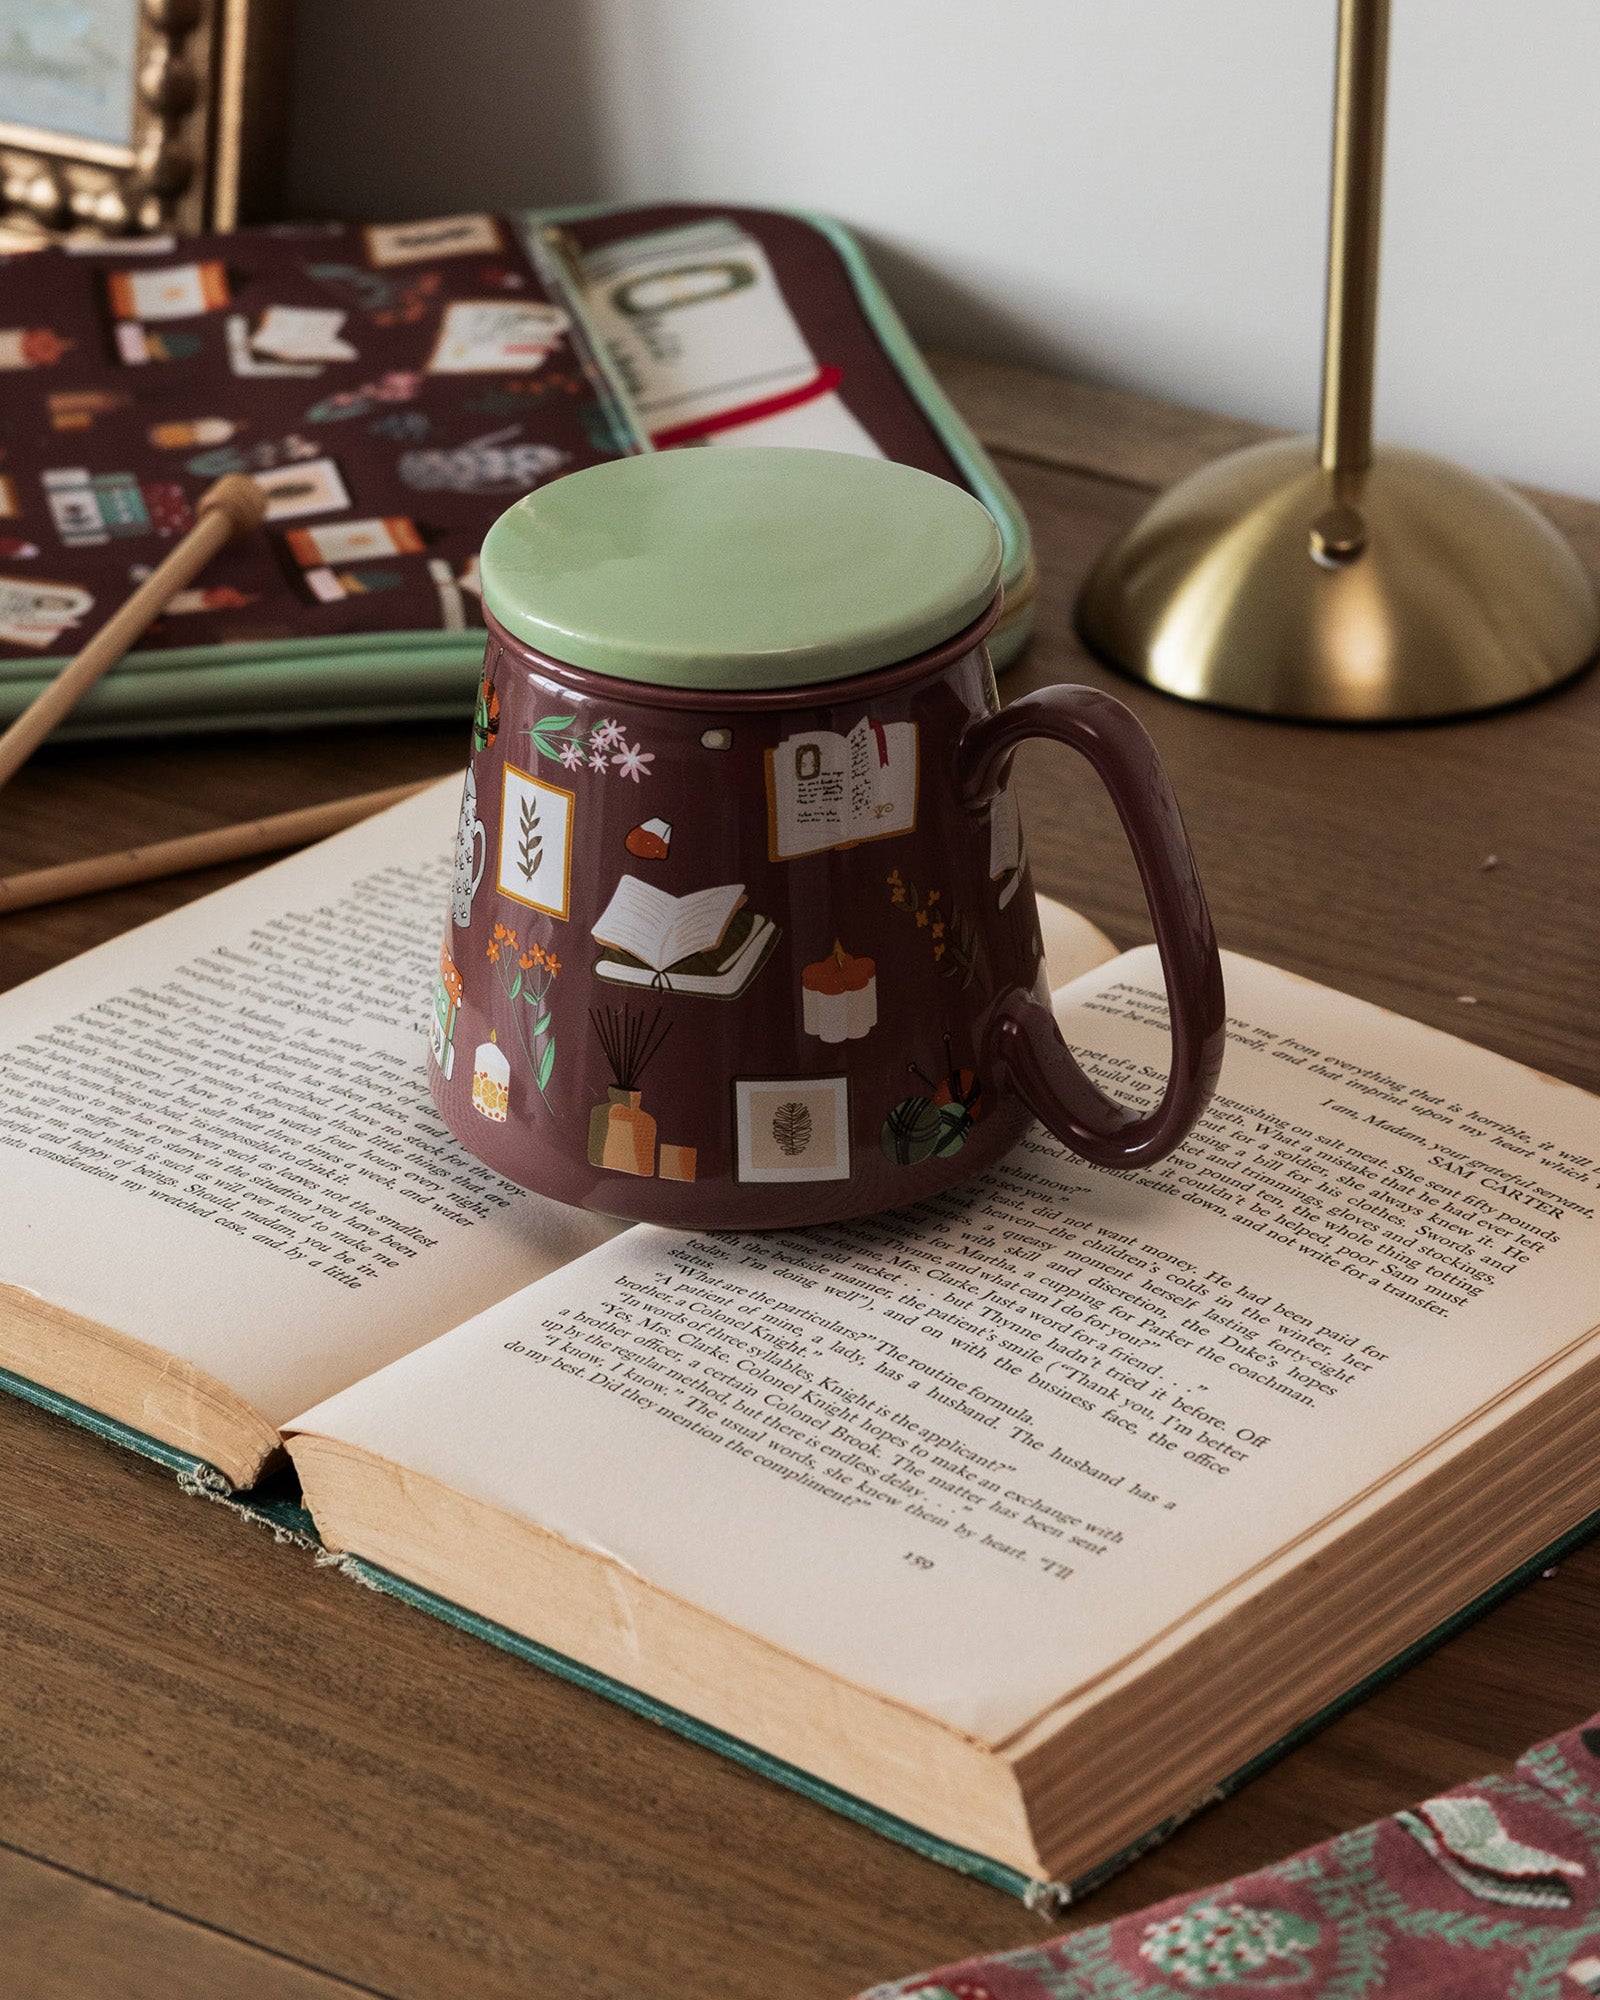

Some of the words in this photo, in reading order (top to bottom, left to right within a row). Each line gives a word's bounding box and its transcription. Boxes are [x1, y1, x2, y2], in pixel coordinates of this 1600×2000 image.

[332, 1103, 349, 1112] I
[344, 1107, 381, 1126] have
[380, 1125, 403, 1136] no
[402, 1136, 445, 1156] stock
[439, 1154, 469, 1167] for
[467, 1166, 496, 1181] the
[496, 1180, 526, 1198] voy-
[1252, 1027, 1279, 1040] me
[1277, 1038, 1321, 1057] from
[1324, 1056, 1406, 1092] everything
[1408, 1088, 1445, 1105] that
[1446, 1103, 1463, 1113] is
[1465, 1110, 1531, 1144] horrible,
[1537, 1141, 1555, 1151] it
[1558, 1150, 1593, 1167] will
[1271, 1050, 1308, 1066] and
[1307, 1064, 1343, 1081] that
[1345, 1078, 1408, 1106] imprint
[1410, 1105, 1454, 1124] upon
[1458, 1124, 1487, 1137] my
[1490, 1135, 1536, 1158] heart
[1540, 1158, 1589, 1182] which
[1320, 1098, 1335, 1107] I
[1330, 1105, 1359, 1120] am,
[1362, 1114, 1426, 1146] Madam,
[1427, 1143, 1470, 1160] your
[1465, 1160, 1537, 1188] grateful
[1532, 1187, 1594, 1219] servant,
[29, 1147, 118, 1181] consideration
[120, 1179, 147, 1192] my
[148, 1189, 218, 1218] wretched
[214, 1217, 247, 1236] case,
[284, 1246, 308, 1260] by
[308, 1260, 323, 1268] a
[322, 1265, 362, 1289] little
[37, 1132, 72, 1145] and
[67, 1140, 112, 1161] happy
[112, 1158, 136, 1169] of
[131, 1164, 179, 1188] beings.
[183, 1183, 240, 1212] Should,
[241, 1210, 296, 1239] madam,
[297, 1236, 332, 1252] you
[332, 1250, 356, 1264] be
[356, 1263, 378, 1278] in-
[1064, 1152, 1086, 1166] he
[1087, 1161, 1139, 1182] would
[1135, 1177, 1180, 1196] settle
[1181, 1192, 1227, 1217] down,
[1231, 1214, 1269, 1232] and
[1265, 1230, 1297, 1247] not
[1298, 1244, 1340, 1267] write
[1340, 1263, 1369, 1280] for
[1367, 1277, 1380, 1286] a
[1382, 1282, 1448, 1318] transfer.
[1158, 1167, 1176, 1178] it
[1178, 1176, 1246, 1206] couldn’t
[1248, 1202, 1271, 1217] be
[1273, 1213, 1333, 1247] helped,
[1334, 1245, 1379, 1266] poor
[1380, 1263, 1419, 1286] Sam
[1423, 1284, 1468, 1307] must
[1166, 1154, 1197, 1170] two
[1196, 1167, 1256, 1192] pound
[1255, 1189, 1284, 1209] ten,
[1292, 1205, 1320, 1222] the
[1325, 1220, 1373, 1246] whole
[1376, 1243, 1422, 1270] thing
[1425, 1265, 1484, 1297] totting
[1197, 1119, 1226, 1133] out
[1229, 1130, 1256, 1144] for
[1257, 1143, 1270, 1151] a
[1273, 1150, 1329, 1177] soldier,
[1335, 1175, 1366, 1191] she
[1368, 1190, 1424, 1216] always
[1426, 1212, 1474, 1236] knew
[1476, 1234, 1494, 1248] it.
[1501, 1245, 1530, 1263] He
[1205, 1154, 1242, 1170] and
[1241, 1166, 1323, 1209] trimmings,
[1326, 1206, 1380, 1232] gloves
[1381, 1230, 1418, 1248] and
[1417, 1246, 1495, 1285] stockings,
[1234, 1149, 1247, 1157] a
[1252, 1154, 1284, 1171] bill
[1285, 1169, 1313, 1184] for
[1315, 1181, 1343, 1198] his
[1347, 1197, 1406, 1228] clothes.
[1414, 1225, 1476, 1256] Swords
[1479, 1256, 1517, 1274] and
[1255, 1122, 1300, 1147] What
[1300, 1145, 1313, 1153] a
[1316, 1151, 1378, 1180] mistake
[1380, 1176, 1416, 1196] that
[1416, 1190, 1440, 1206] he
[1441, 1201, 1478, 1221] had
[1476, 1219, 1514, 1237] ever
[1513, 1233, 1545, 1253] left
[1290, 1126, 1313, 1138] on
[1314, 1135, 1345, 1150] salt
[1345, 1147, 1388, 1169] meat.
[1391, 1165, 1425, 1183] She
[1424, 1181, 1462, 1198] sent
[1461, 1194, 1498, 1214] fifty
[1495, 1212, 1560, 1243] pounds
[1427, 1156, 1476, 1179] SAM
[1480, 1178, 1564, 1220] CARTER
[614, 1275, 673, 1303] brother,
[674, 1299, 687, 1307] a
[688, 1302, 754, 1331] Colonel
[986, 1190, 1025, 1211] least,
[1031, 1206, 1063, 1220] did
[1062, 1217, 1093, 1230] not
[1097, 1227, 1138, 1246] want
[1140, 1244, 1197, 1274] money.
[1203, 1270, 1232, 1288] He
[1235, 1285, 1272, 1306] had
[1272, 1302, 1313, 1327] been
[1314, 1326, 1360, 1347] paid
[1360, 1344, 1389, 1361] for
[503, 1340, 526, 1353] do
[524, 1349, 552, 1364] my
[550, 1356, 585, 1378] best.
[587, 1372, 625, 1392] Did
[620, 1387, 658, 1410] they
[656, 1406, 724, 1443] mention
[724, 1439, 754, 1457] the
[686, 1238, 731, 1260] today,
[737, 1255, 768, 1271] I’m
[772, 1268, 818, 1289] doing
[882, 1309, 920, 1326] and
[920, 1325, 944, 1339] on
[951, 1337, 987, 1359] with
[993, 1356, 1022, 1375] the
[1027, 1372, 1096, 1411] business
[1101, 1408, 1138, 1435] face,
[1147, 1431, 1178, 1450] the
[1183, 1450, 1230, 1474] office
[721, 1283, 749, 1295] are
[747, 1290, 776, 1305] the
[875, 1339, 908, 1362] The
[907, 1358, 968, 1391] routine
[967, 1386, 1033, 1426] formula.
[903, 1552, 935, 1570] 159
